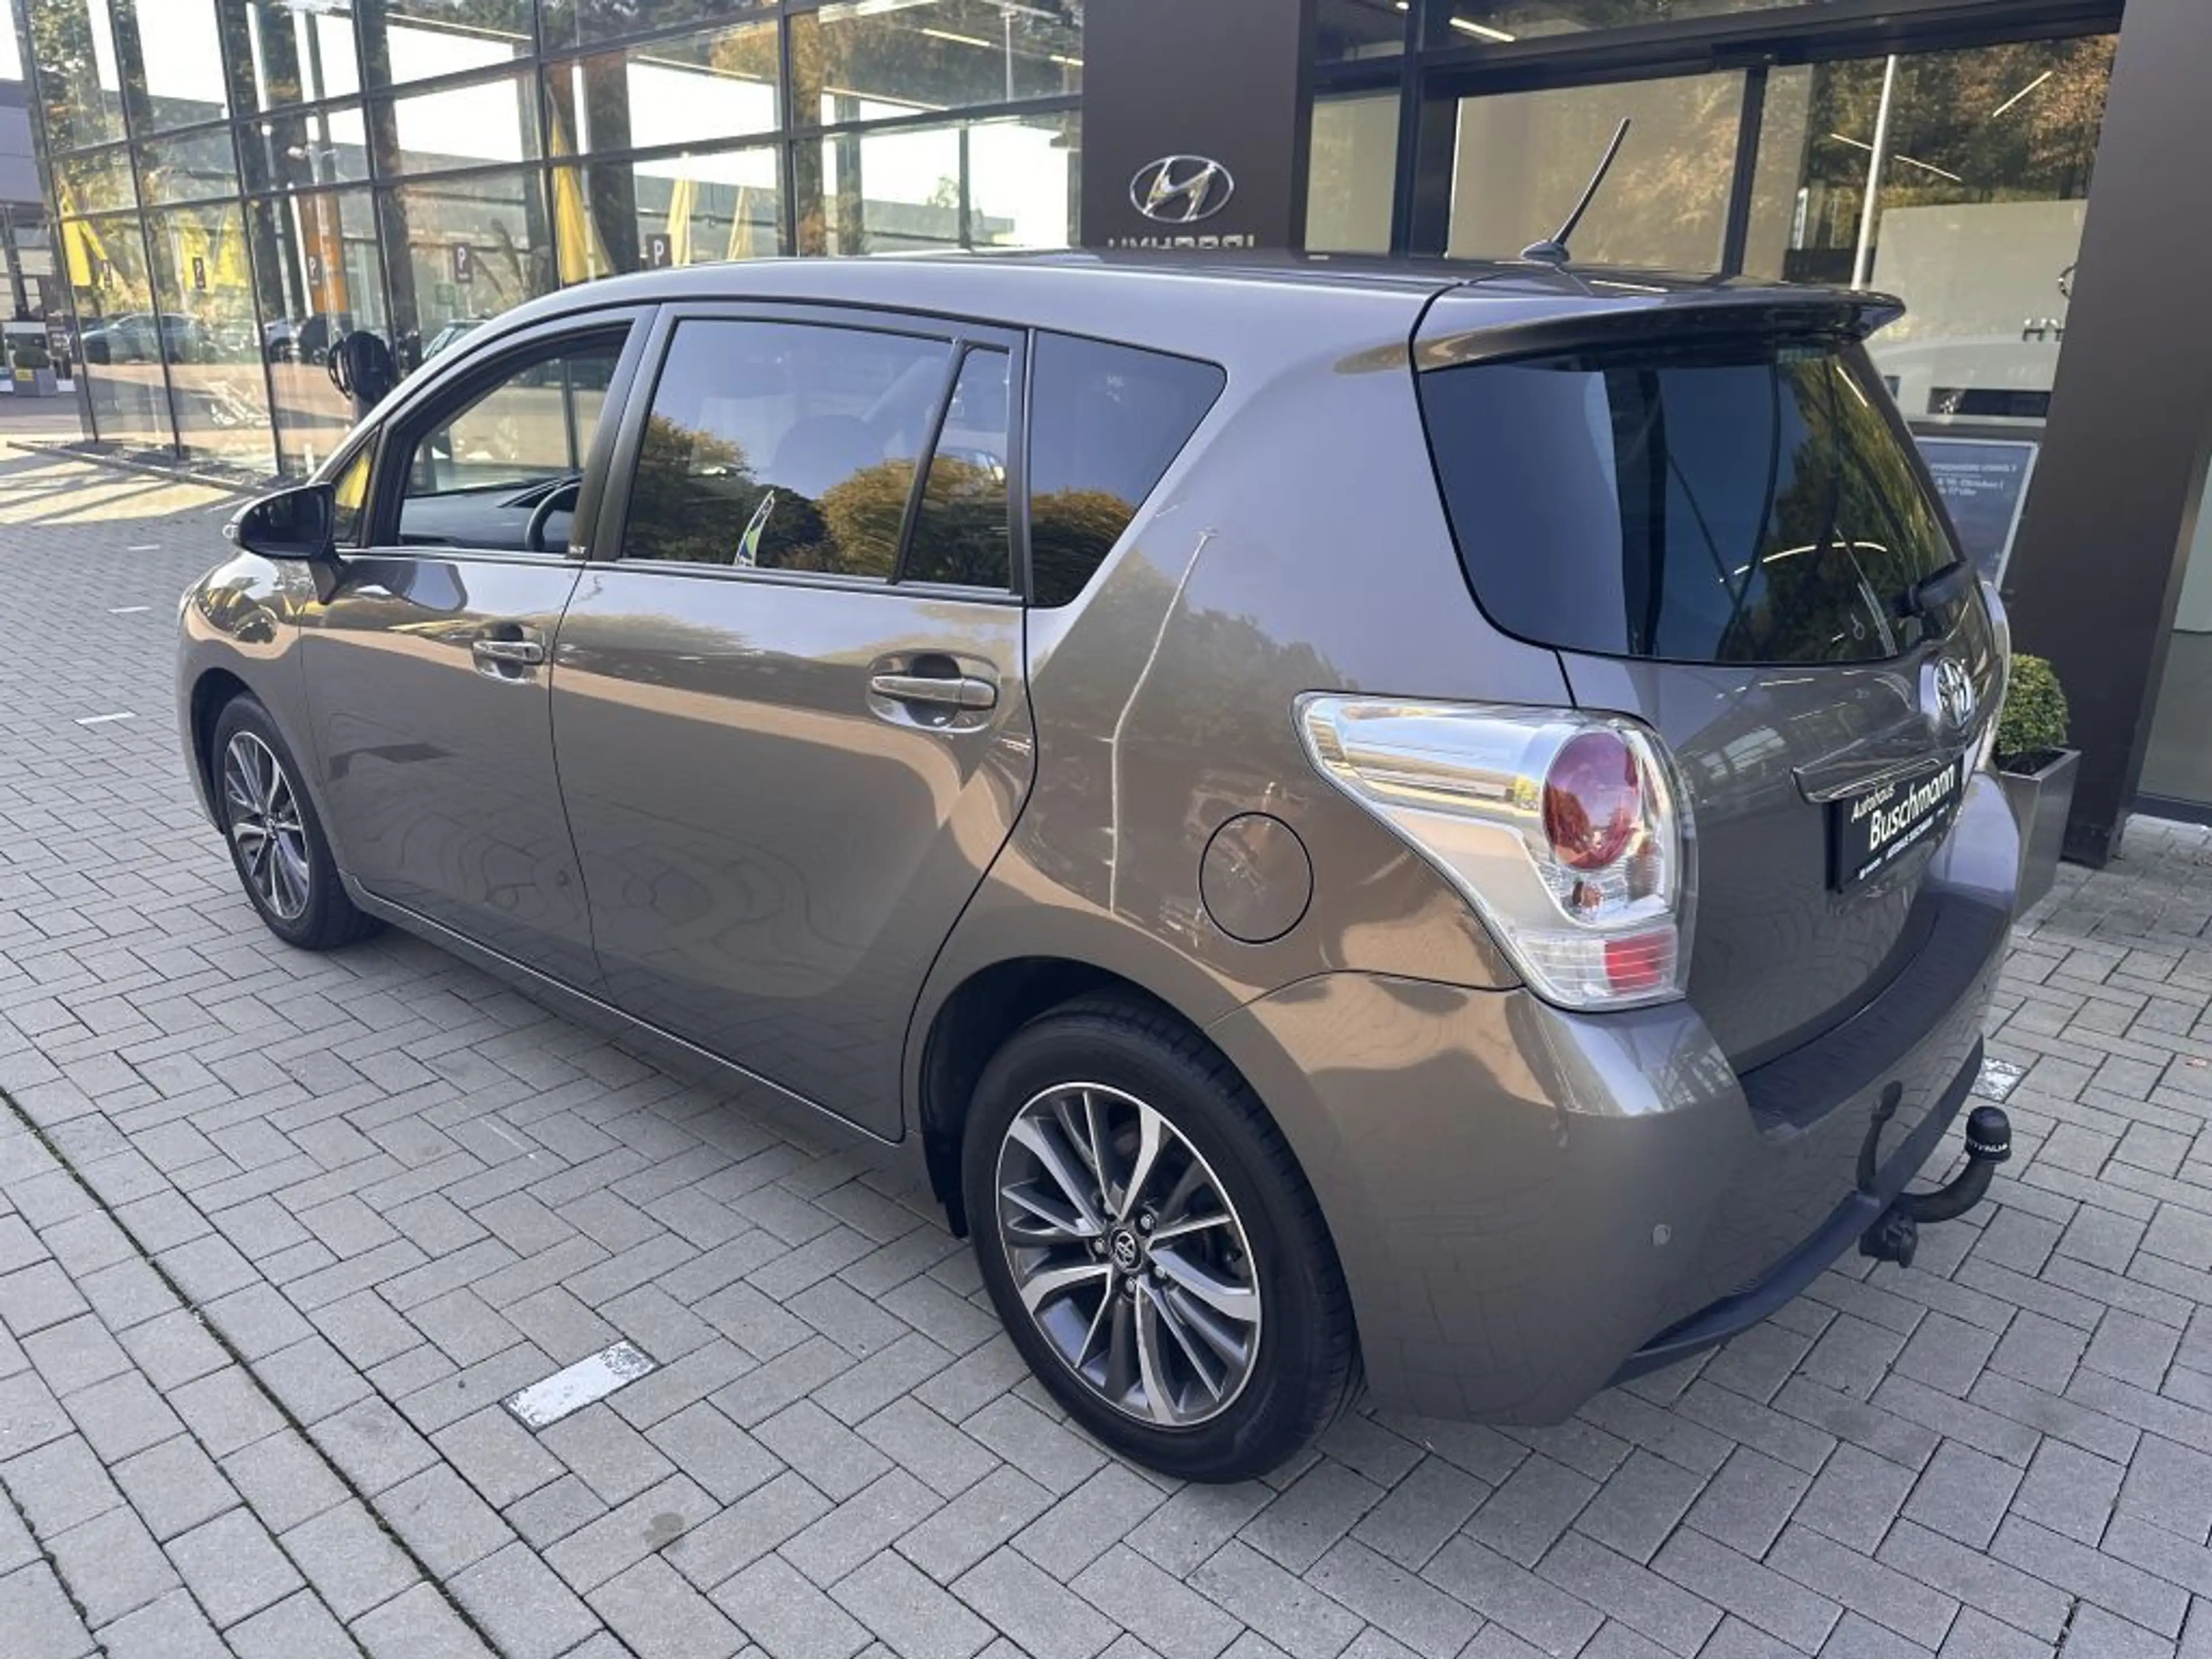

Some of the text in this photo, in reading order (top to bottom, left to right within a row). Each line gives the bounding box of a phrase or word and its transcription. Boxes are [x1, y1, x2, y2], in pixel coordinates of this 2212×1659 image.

[653, 239, 665, 266] P
[1851, 782, 1896, 824] Autohaus
[1870, 763, 1955, 851] Buschmann
